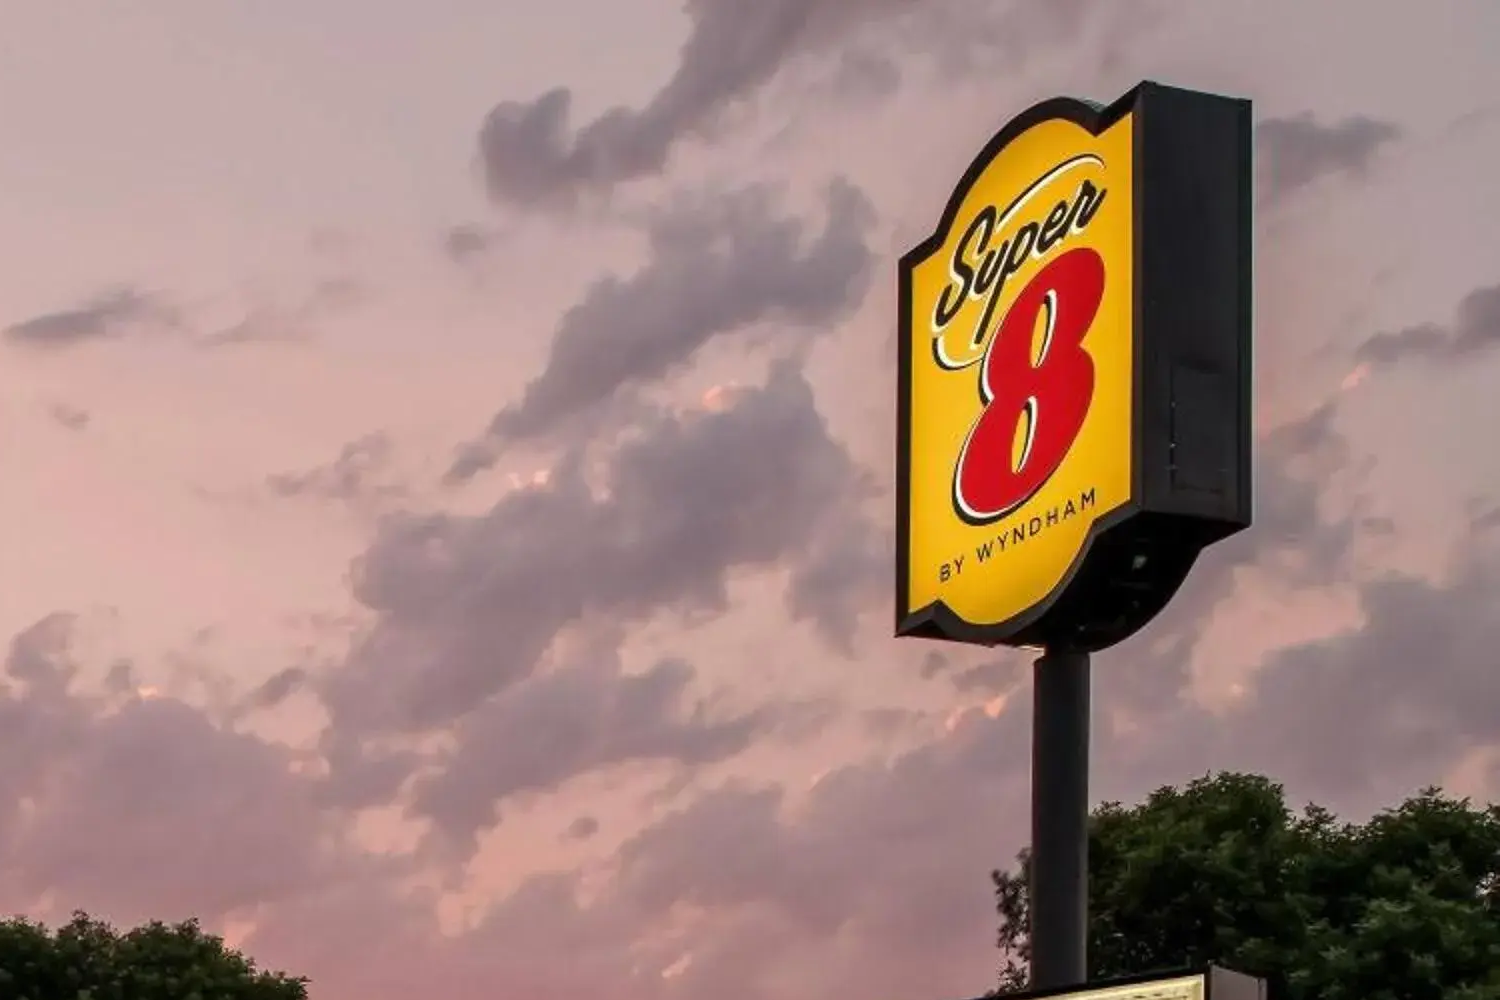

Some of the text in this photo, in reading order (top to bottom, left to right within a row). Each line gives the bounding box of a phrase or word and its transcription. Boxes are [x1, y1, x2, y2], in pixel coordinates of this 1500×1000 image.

[931, 176, 1107, 350] Super
[951, 246, 1106, 527] 8
[939, 487, 1095, 582] BY WYNDHAM
